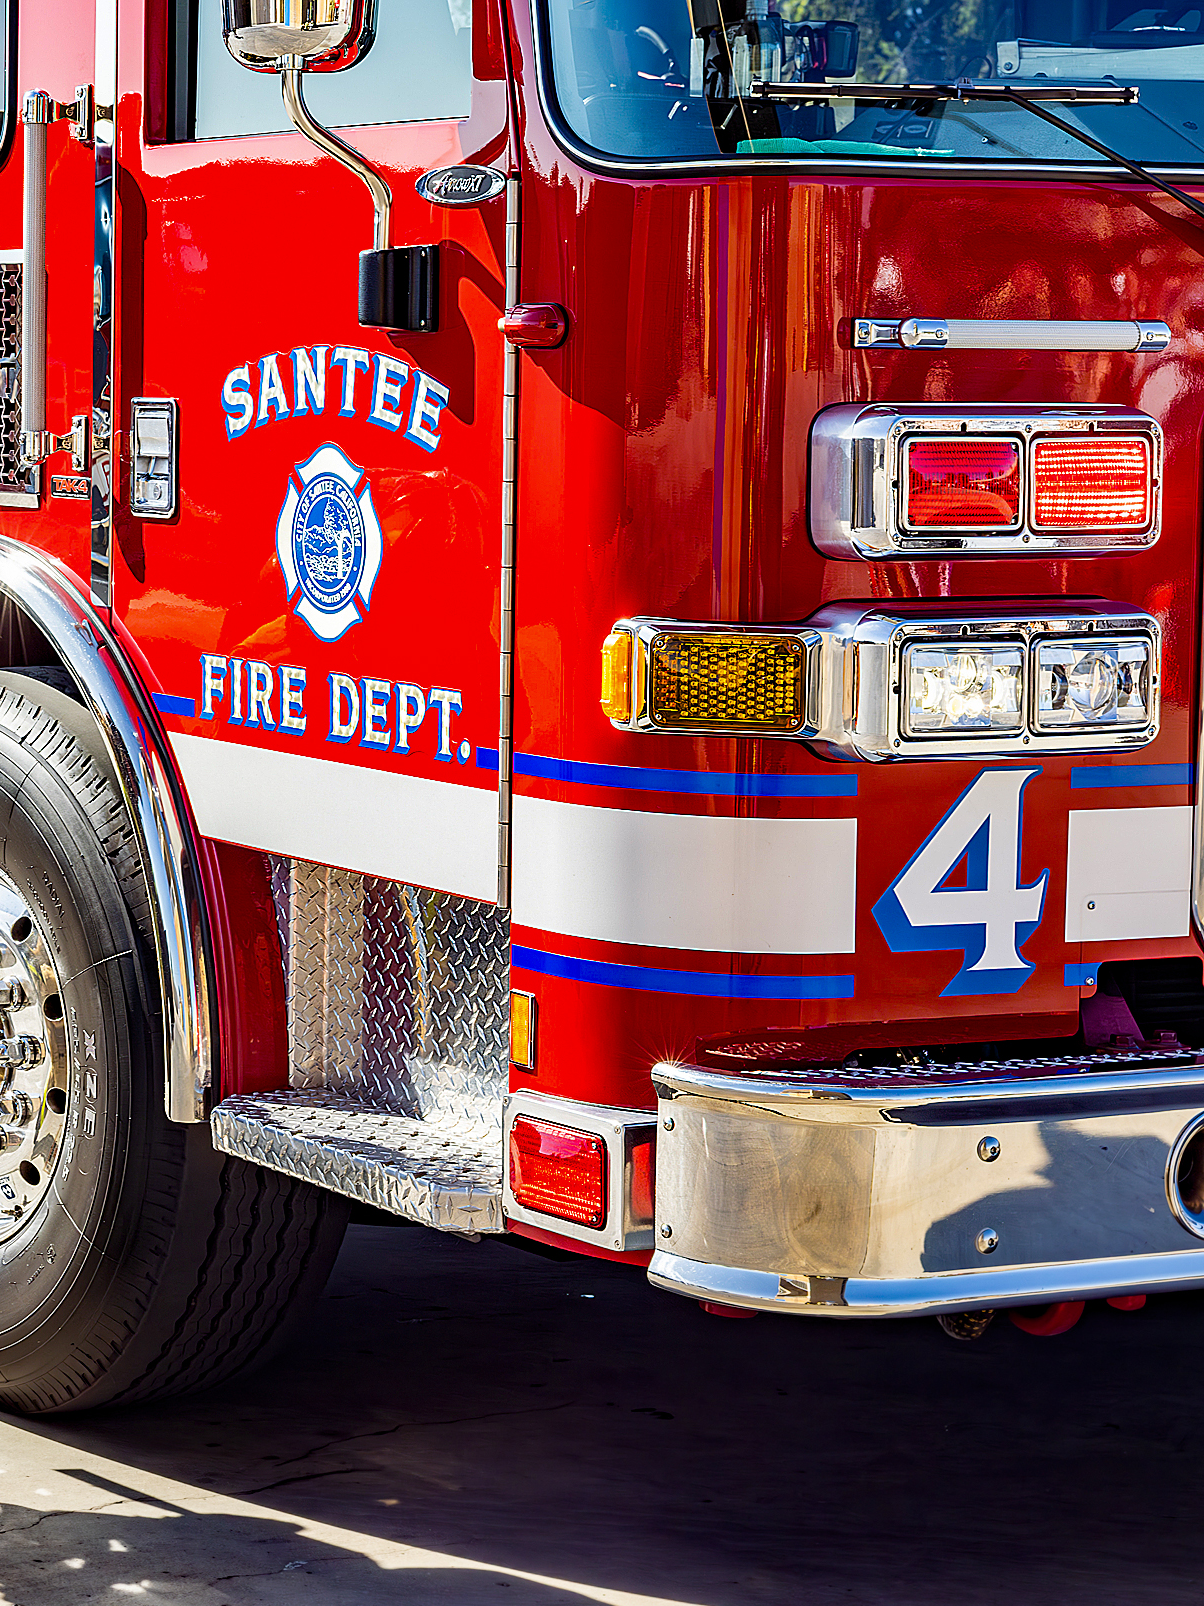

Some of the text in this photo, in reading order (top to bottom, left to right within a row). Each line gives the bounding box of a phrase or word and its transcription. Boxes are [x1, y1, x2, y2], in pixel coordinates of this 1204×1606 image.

[221, 346, 450, 453] SANTEE
[52, 478, 89, 494] TAK-4
[296, 513, 305, 542] CITY
[301, 495, 311, 513] OF
[199, 654, 470, 765] FIRE DEPT.
[871, 765, 1050, 997] 4
